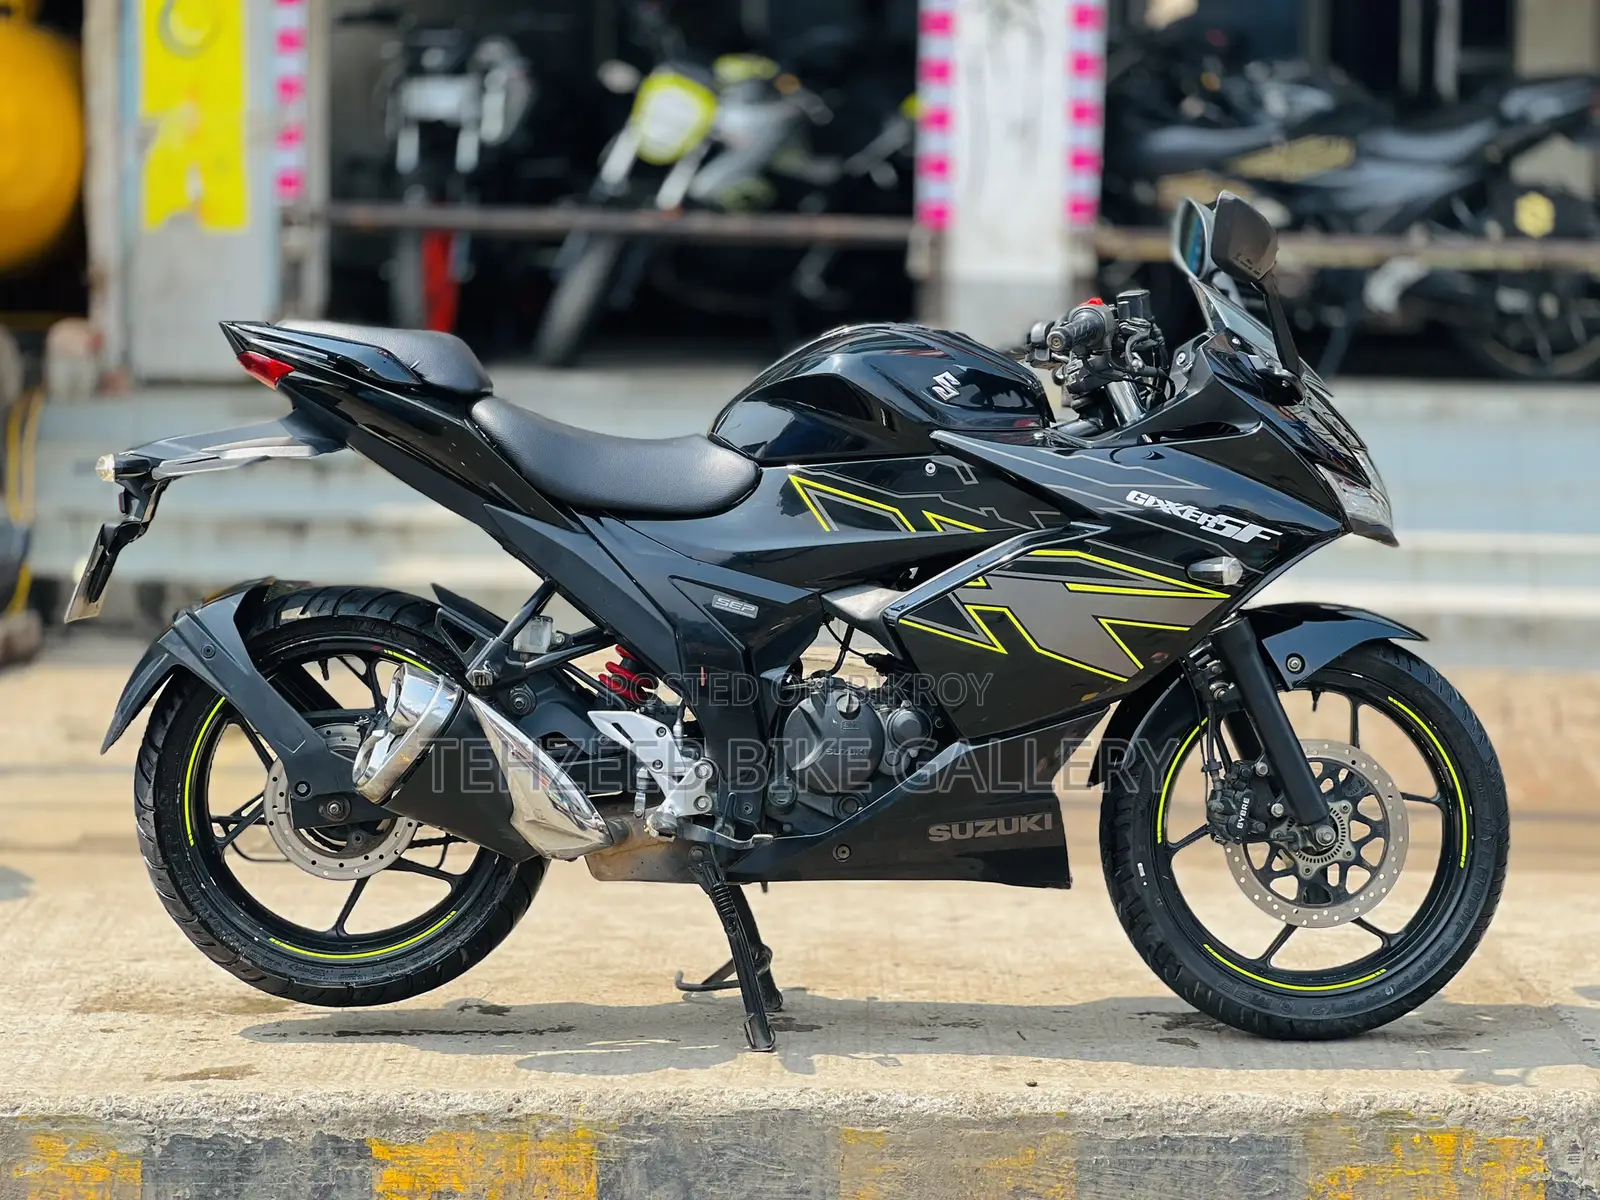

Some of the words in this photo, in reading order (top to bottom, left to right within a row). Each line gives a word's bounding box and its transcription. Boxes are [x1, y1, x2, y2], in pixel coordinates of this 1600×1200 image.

[1199, 513, 1284, 544] SF
[714, 597, 756, 612] SEP
[927, 811, 1053, 843] SUZUKI
[1236, 797, 1251, 830] BYBRE
